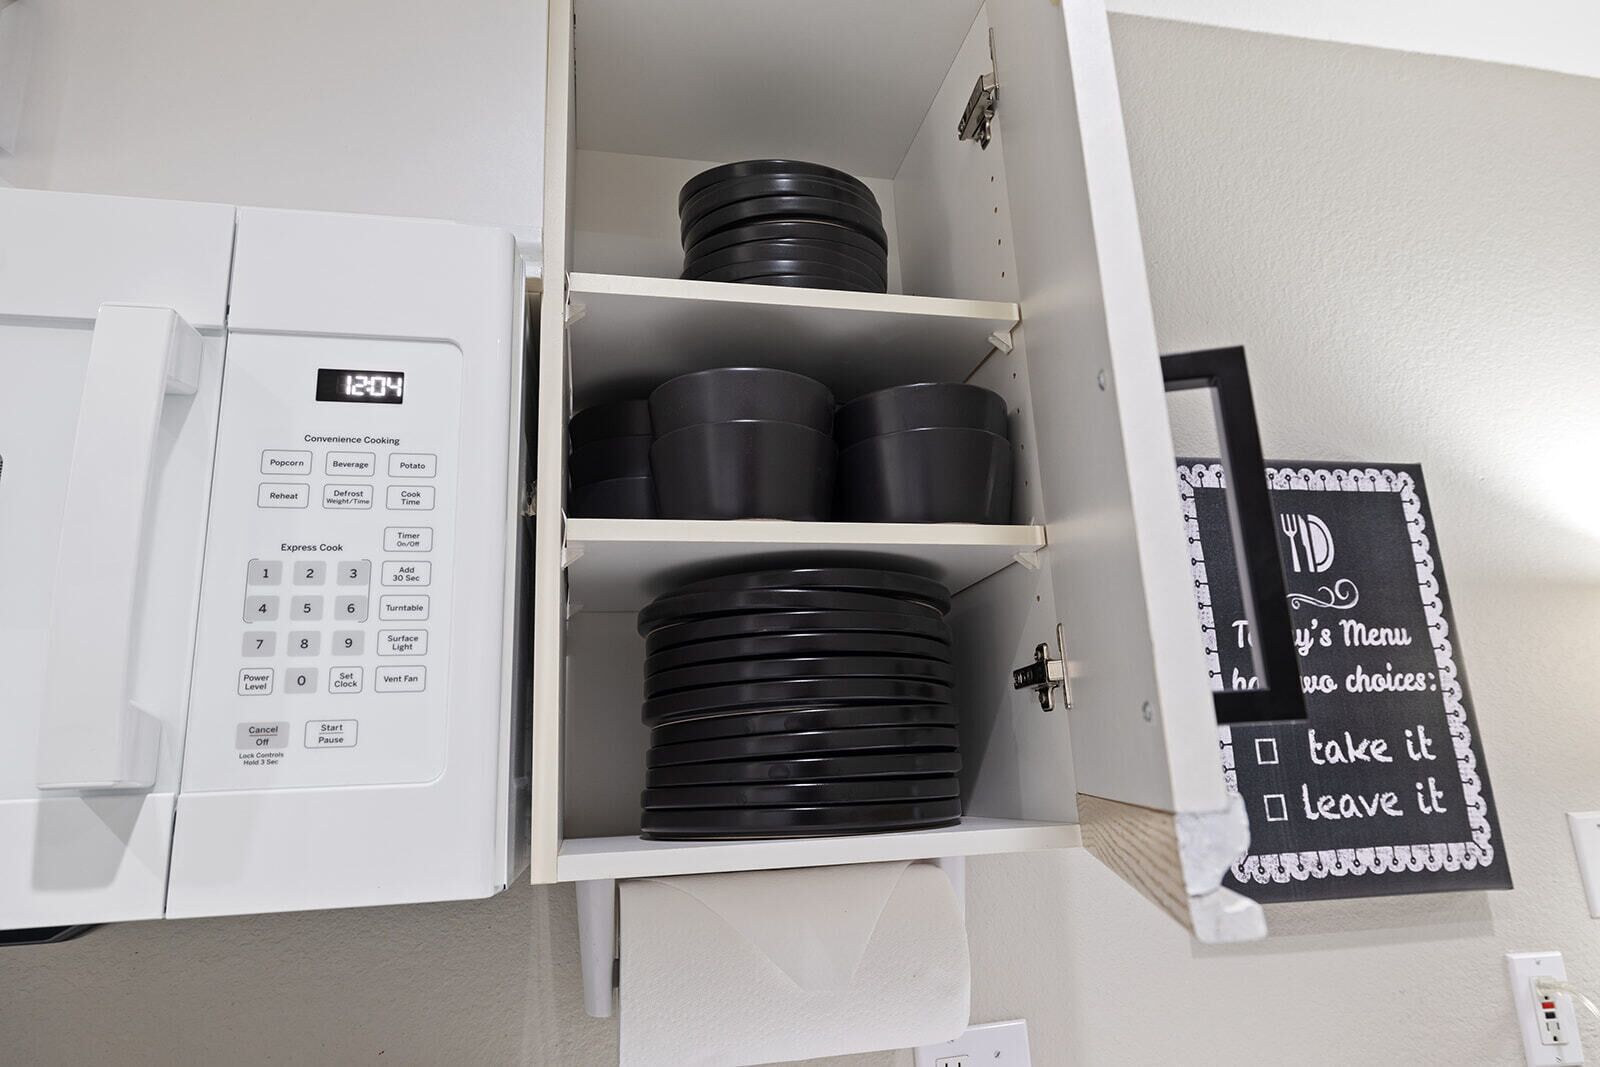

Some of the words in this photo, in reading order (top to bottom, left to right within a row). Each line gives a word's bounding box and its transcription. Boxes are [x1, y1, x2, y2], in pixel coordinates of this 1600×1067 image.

[345, 375, 403, 397] 12:04
[304, 434, 361, 445] Convenience
[363, 435, 400, 446] Cooking
[270, 459, 304, 468] Popcorn
[332, 460, 369, 469] Beverage
[400, 461, 426, 470] Potato
[270, 491, 298, 500] Reheat
[333, 489, 364, 498] Defrost
[401, 490, 421, 498] Cook
[326, 497, 370, 506] Weight/Time
[401, 498, 421, 506] Time
[397, 531, 420, 540] Timer
[281, 543, 317, 553] Express
[319, 543, 344, 552] Cook
[396, 540, 420, 548] On/Off
[263, 569, 268, 578] 1
[306, 569, 314, 578] 2
[349, 569, 358, 578] 3
[399, 566, 415, 574] Add
[392, 574, 404, 582] 30
[405, 574, 420, 582] Sec
[258, 603, 267, 613] 4
[303, 603, 312, 613] 5
[347, 603, 355, 613] 6
[386, 604, 424, 612] Turntable
[1338, 619, 1412, 647] Menu
[344, 638, 353, 648] 9
[387, 634, 418, 643] Surface
[256, 639, 264, 649] 7
[300, 639, 308, 649] 8
[392, 643, 413, 652] Light
[243, 674, 270, 683] Power
[297, 675, 306, 686] 0
[339, 672, 353, 680] Set
[383, 675, 401, 683] Vent
[403, 675, 418, 683] Fan
[1300, 674, 1338, 693] wo
[1345, 662, 1438, 693] choices:
[244, 682, 267, 691] Level
[334, 680, 357, 688] Clock
[248, 725, 279, 734] Cancel
[321, 723, 343, 732] Start
[255, 737, 269, 746] Off
[318, 736, 344, 744] Pause
[1307, 728, 1393, 765] take
[1404, 725, 1437, 761] it
[1302, 783, 1404, 820] leave
[1415, 777, 1448, 814] it
